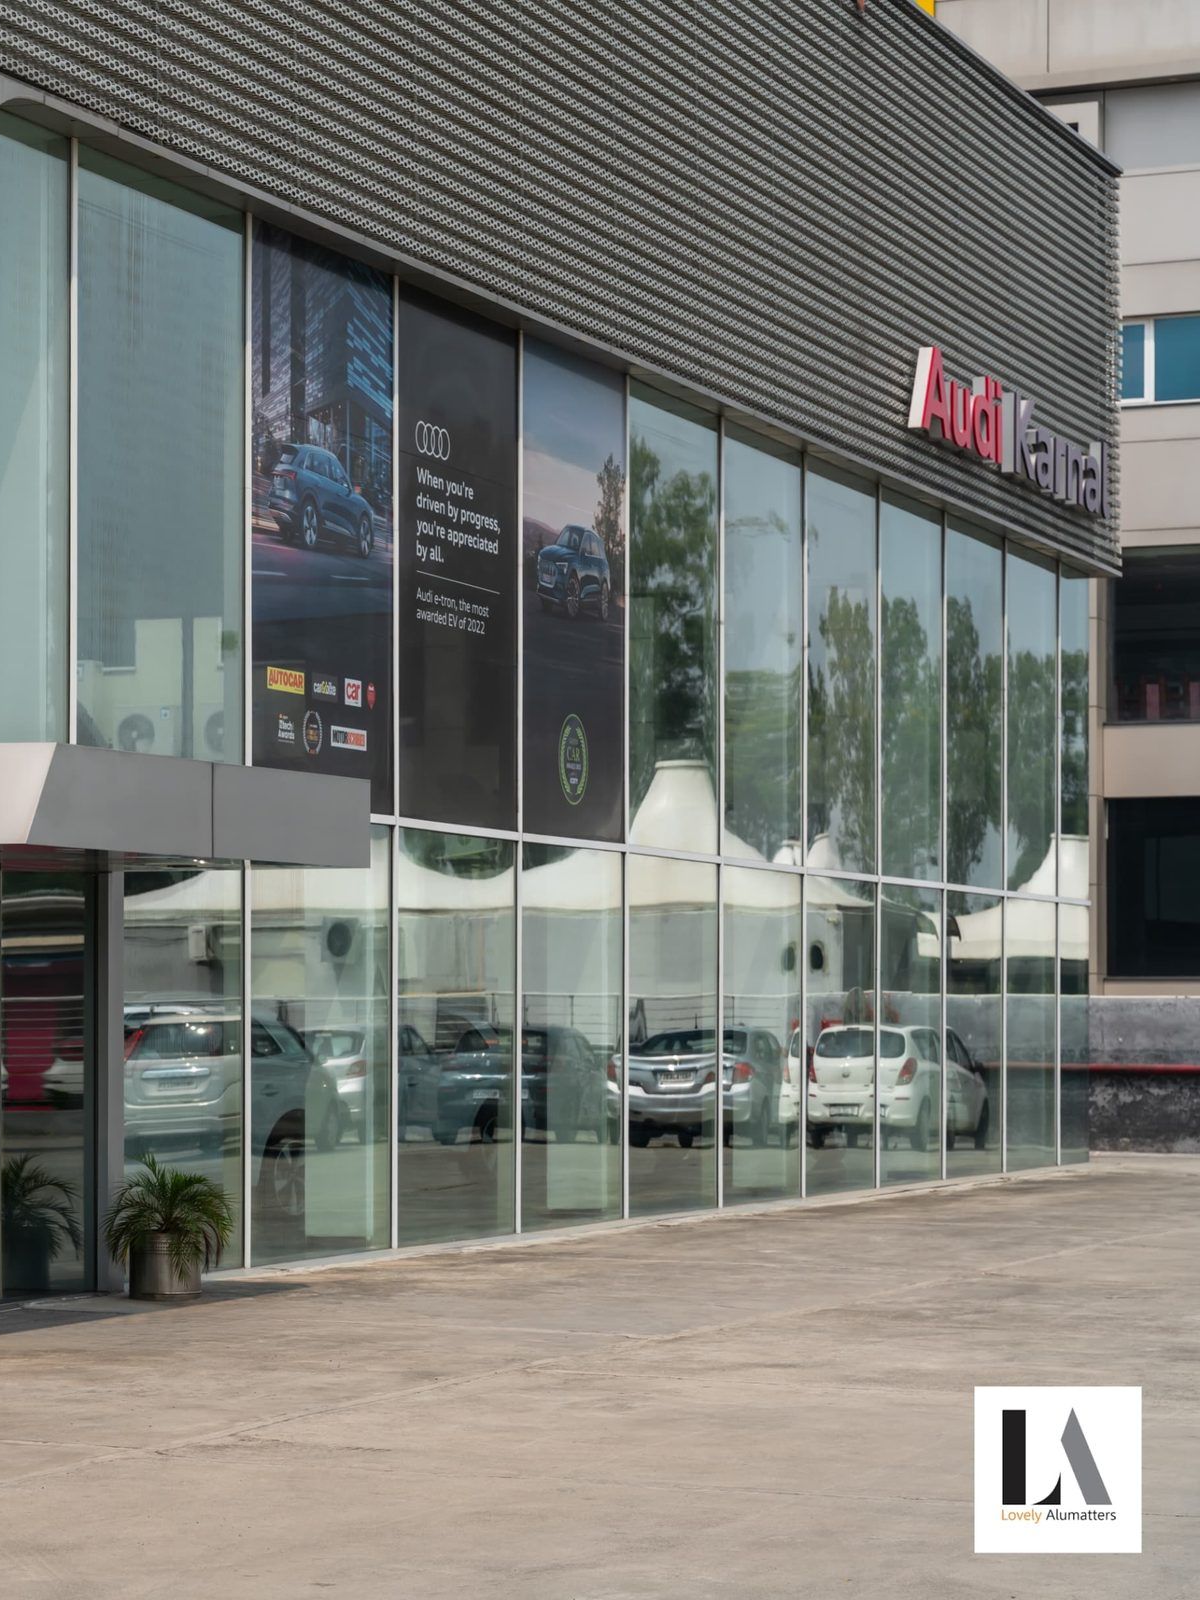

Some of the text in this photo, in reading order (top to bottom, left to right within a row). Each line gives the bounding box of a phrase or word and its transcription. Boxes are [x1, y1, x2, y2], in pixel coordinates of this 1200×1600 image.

[908, 346, 1112, 519] Audi Karnal
[416, 466, 474, 500] When you're
[416, 492, 501, 535] driven by progress,
[416, 519, 499, 555] you're appreciated
[416, 539, 445, 563] by all.
[416, 586, 490, 618] Audi e-tron, the most
[416, 608, 486, 635] awarded EV of 2022
[269, 669, 303, 688] AUTOCAR
[346, 682, 360, 701] car
